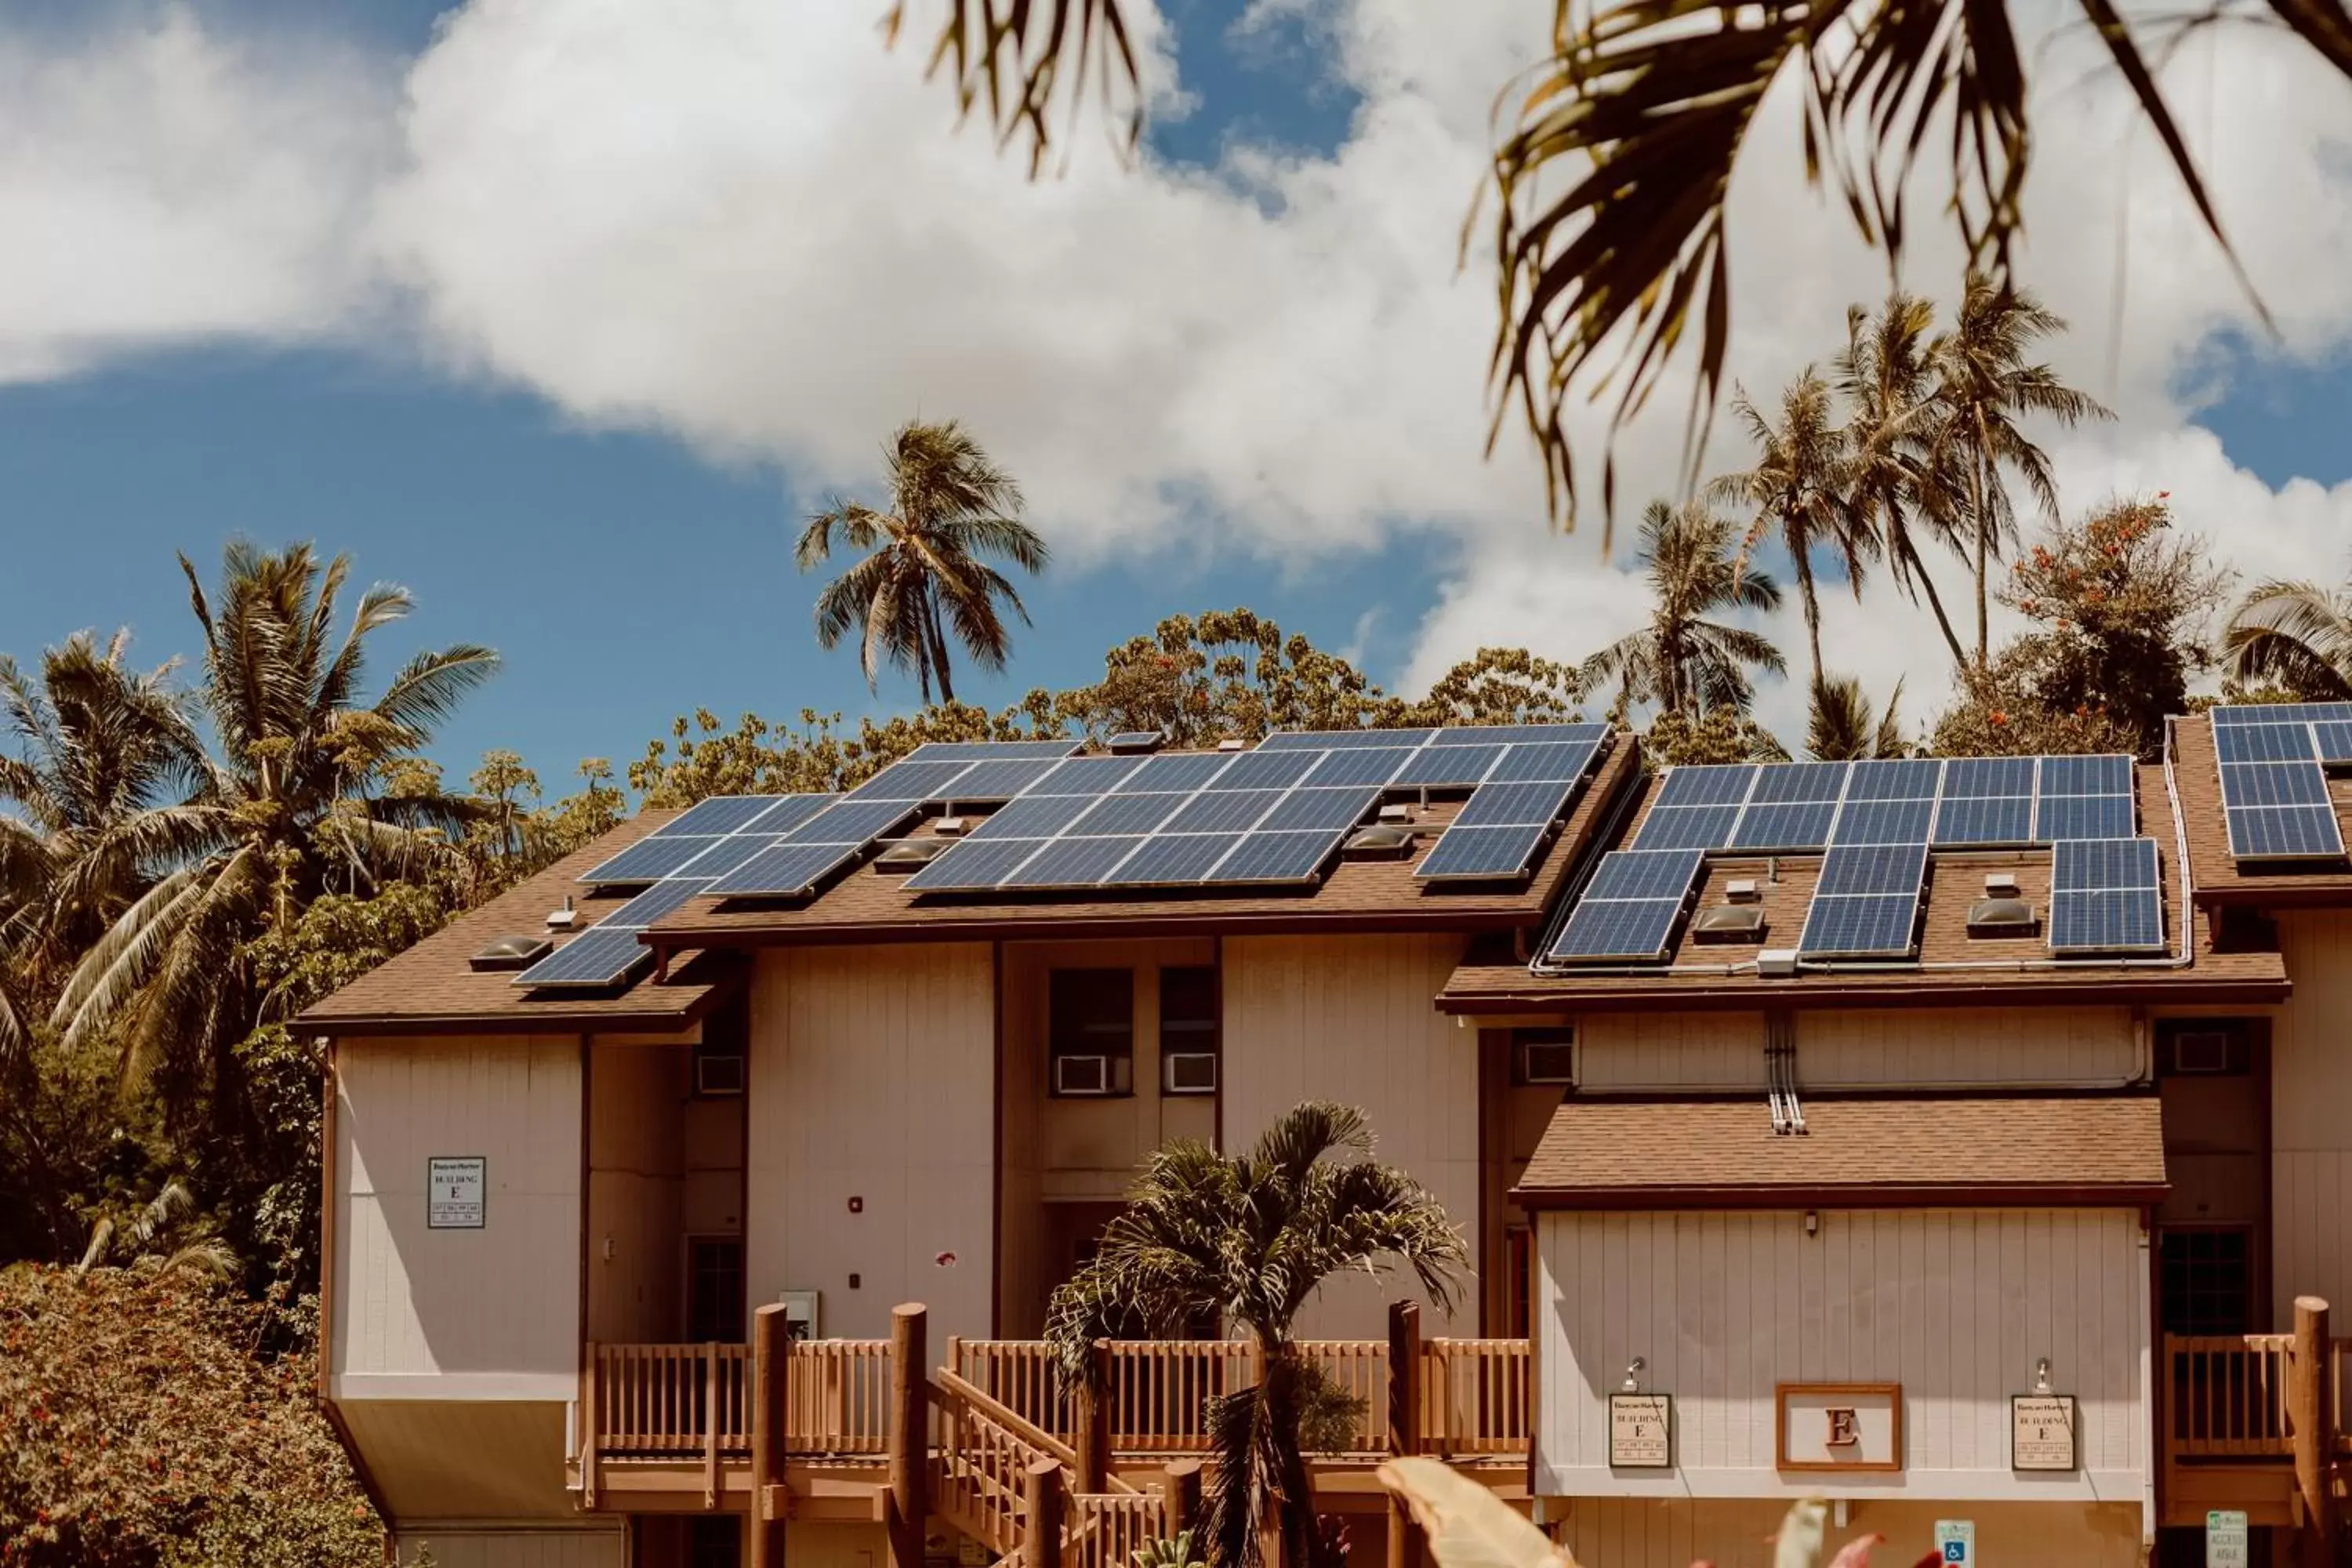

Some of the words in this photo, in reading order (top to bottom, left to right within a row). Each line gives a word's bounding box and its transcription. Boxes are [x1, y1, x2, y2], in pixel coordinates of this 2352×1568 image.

[452, 1186, 461, 1198] E
[1635, 1425, 1646, 1437] E
[1824, 1406, 1857, 1446] E
[2039, 1428, 2049, 1439] E
